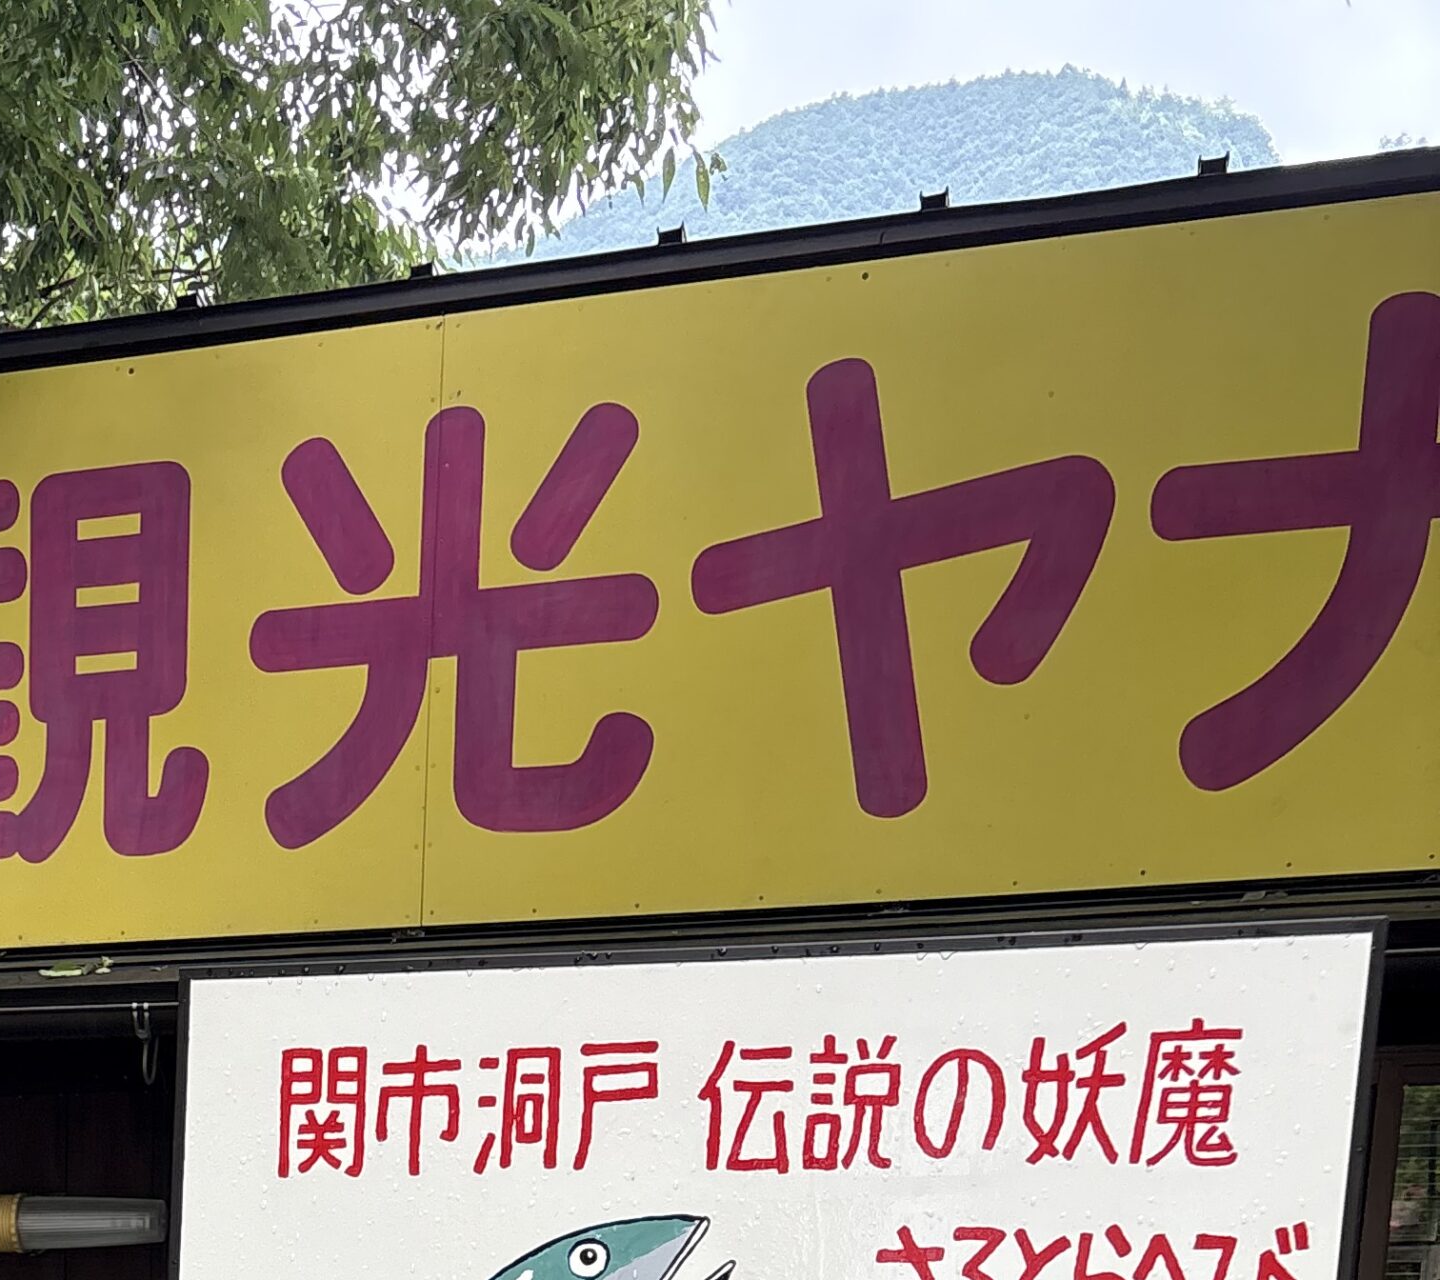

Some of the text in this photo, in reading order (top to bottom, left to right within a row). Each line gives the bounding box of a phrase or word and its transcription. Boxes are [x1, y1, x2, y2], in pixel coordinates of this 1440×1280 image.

[279, 1019, 1243, 1178] 関市洞戸 伝説の妖魔
